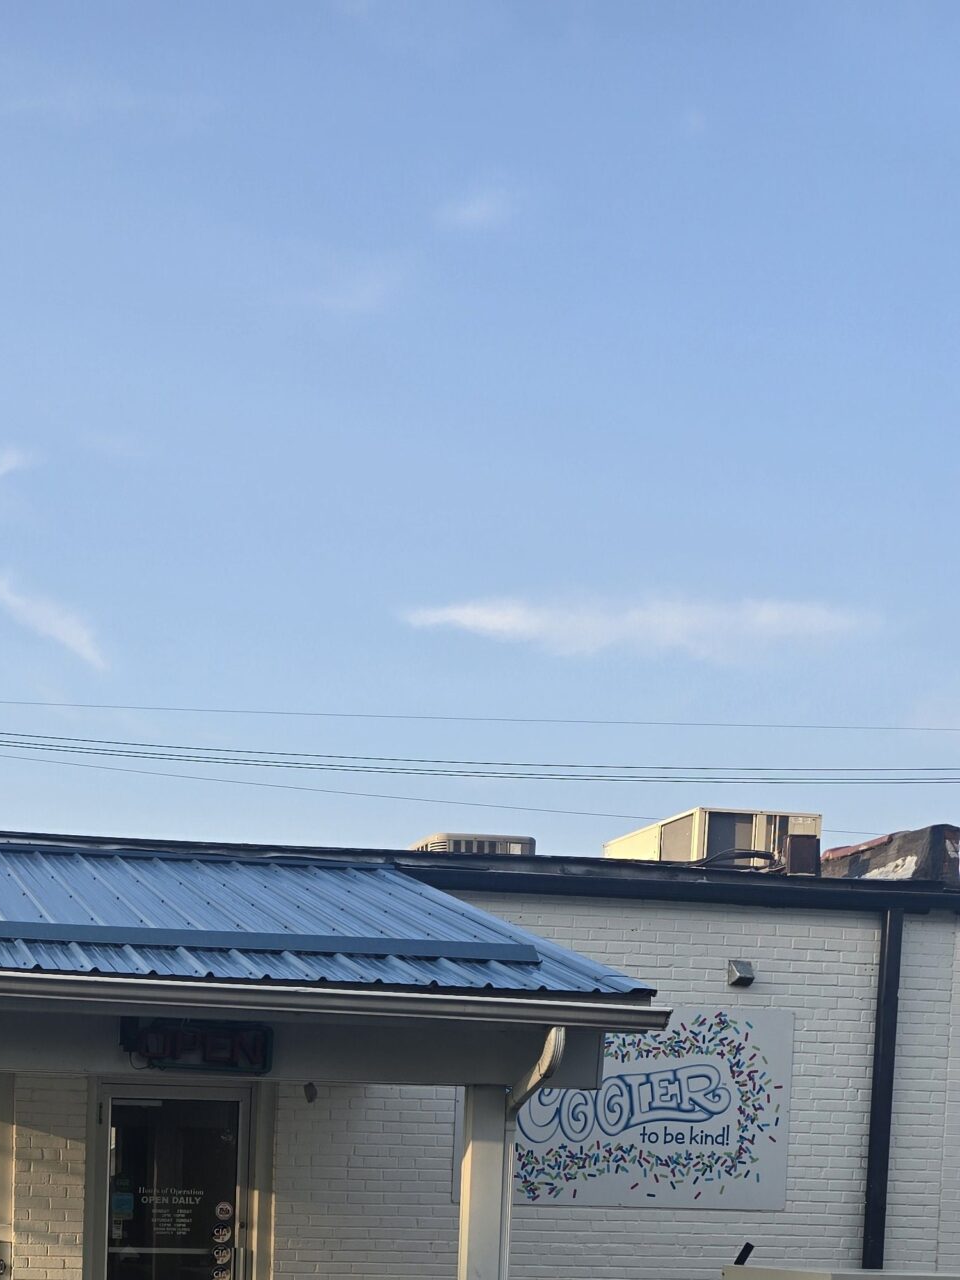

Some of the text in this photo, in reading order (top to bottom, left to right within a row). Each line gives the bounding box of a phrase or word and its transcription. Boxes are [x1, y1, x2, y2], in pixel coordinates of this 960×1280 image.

[138, 1029, 263, 1064] OPEN
[640, 1125, 731, 1145] to be kind!
[170, 1187, 204, 1195] Operation
[141, 1196, 202, 1204] OPEN DAILY
